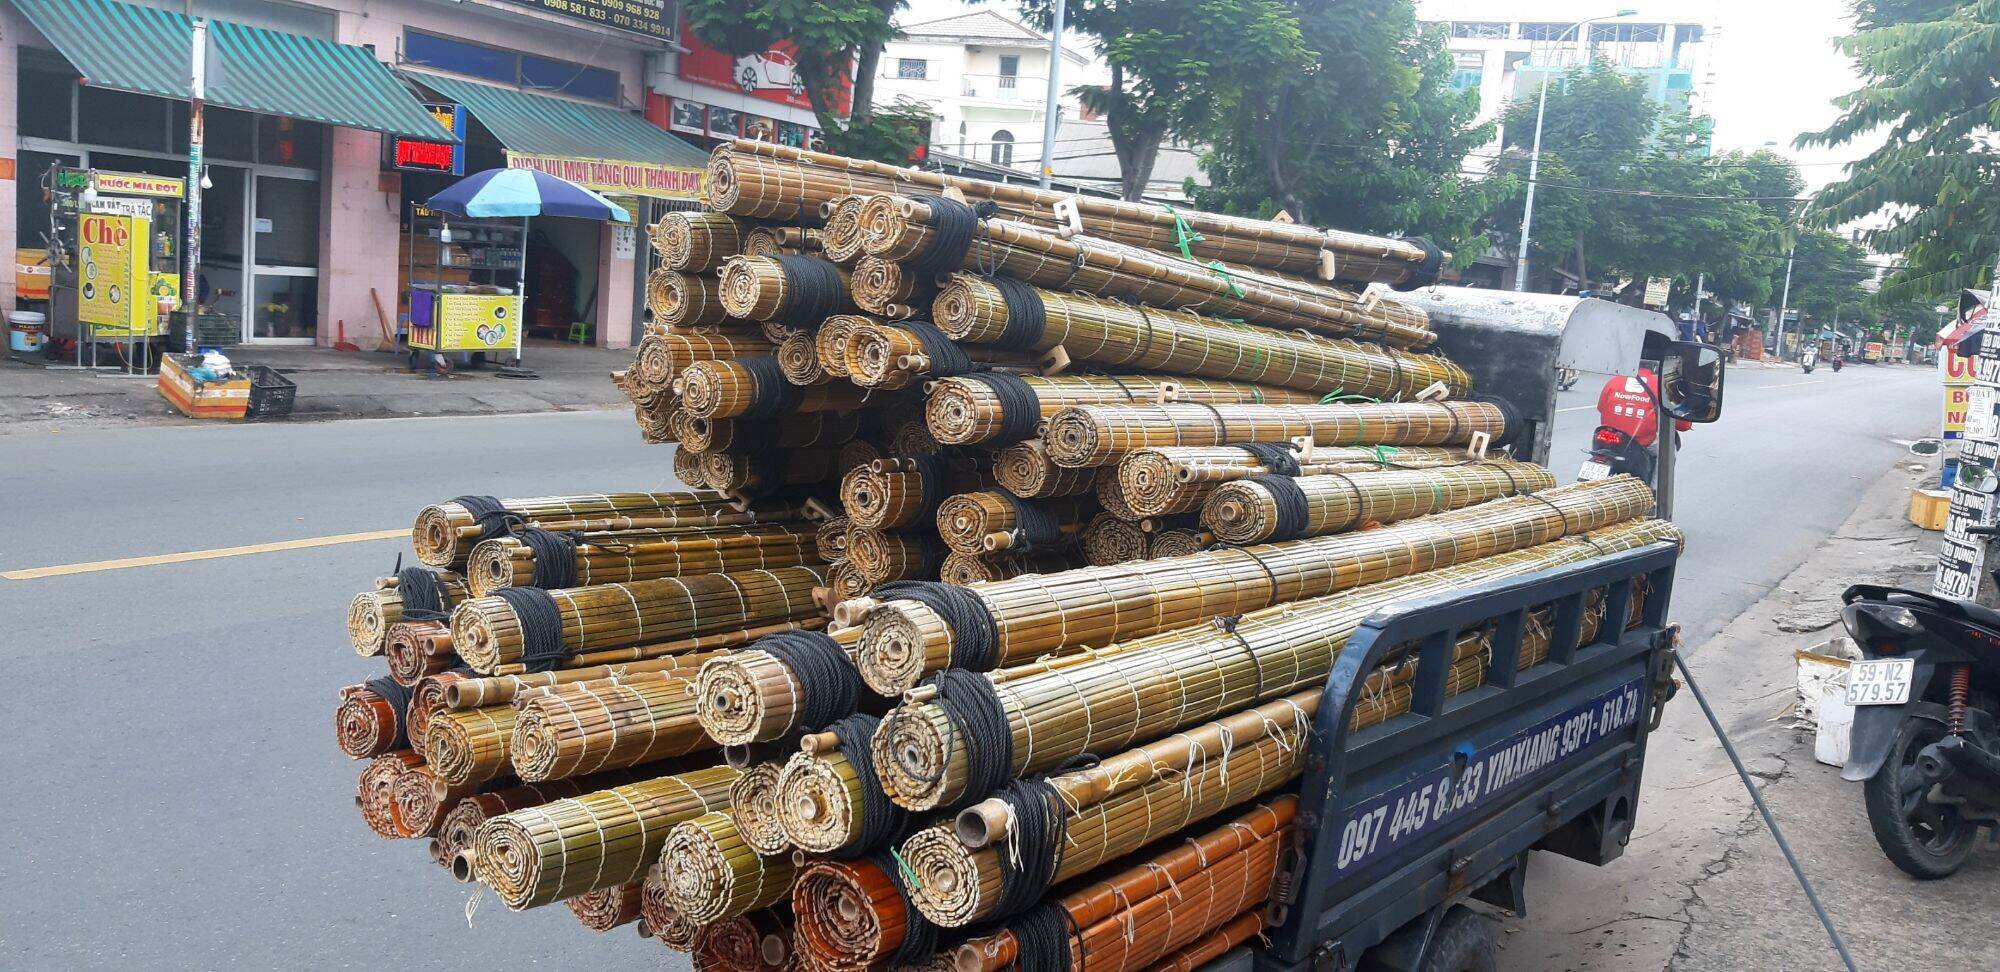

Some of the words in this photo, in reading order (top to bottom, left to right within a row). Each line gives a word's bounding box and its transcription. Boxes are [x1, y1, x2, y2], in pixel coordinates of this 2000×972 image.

[569, 2, 587, 16] 581
[589, 8, 607, 20] 833
[563, 160, 589, 183] MAI
[83, 217, 128, 247] Chè
[1614, 391, 1651, 403] NowFood
[1858, 662, 1904, 682] 59-N2
[1850, 683, 1906, 702] 579.57
[1337, 805, 1388, 870] 097
[1388, 784, 1433, 843] 445
[1432, 761, 1484, 822] 833
[1484, 728, 1559, 796] YINXIANG
